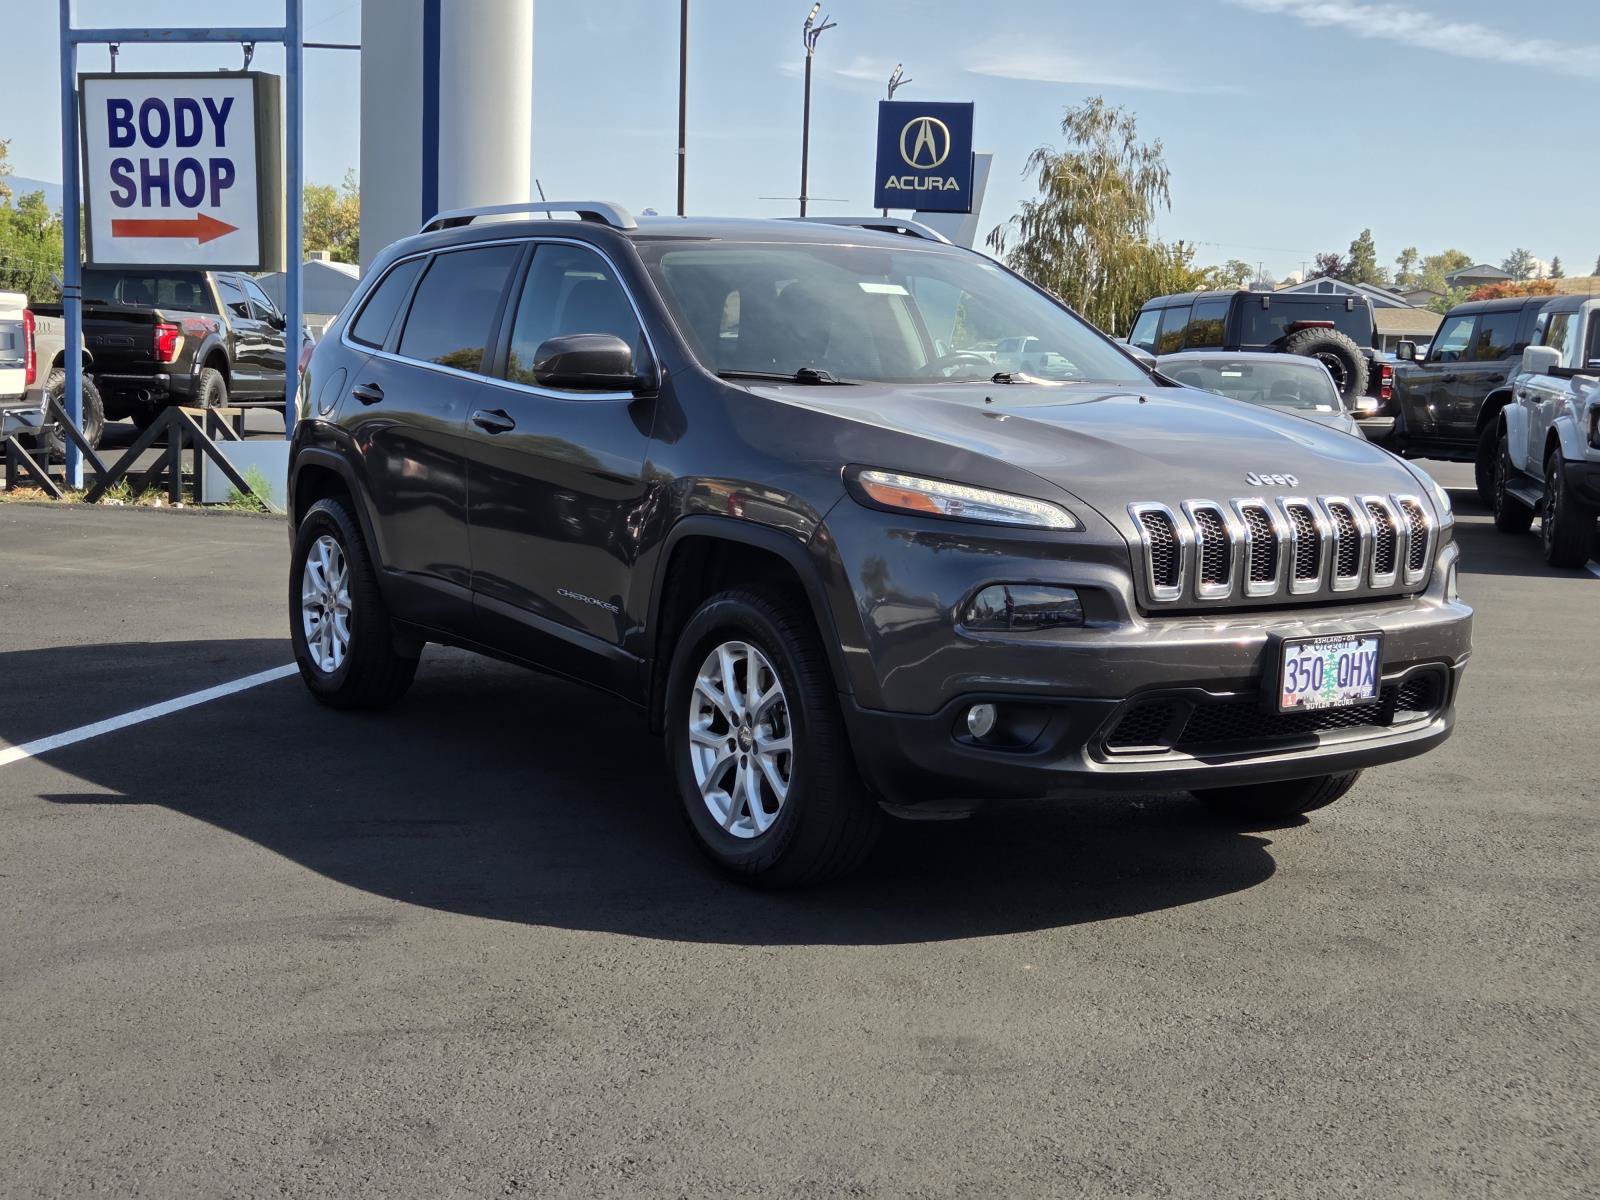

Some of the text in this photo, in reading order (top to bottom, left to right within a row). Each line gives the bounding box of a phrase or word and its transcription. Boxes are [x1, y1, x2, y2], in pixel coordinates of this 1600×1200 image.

[107, 97, 235, 148] BODY
[110, 157, 235, 208] SHOP
[885, 175, 960, 191] ACURA
[1245, 472, 1299, 488] Jeep
[557, 588, 620, 614] CHEROKEE
[1285, 652, 1376, 693] 350 QHX
[1334, 699, 1354, 707] ACURA
